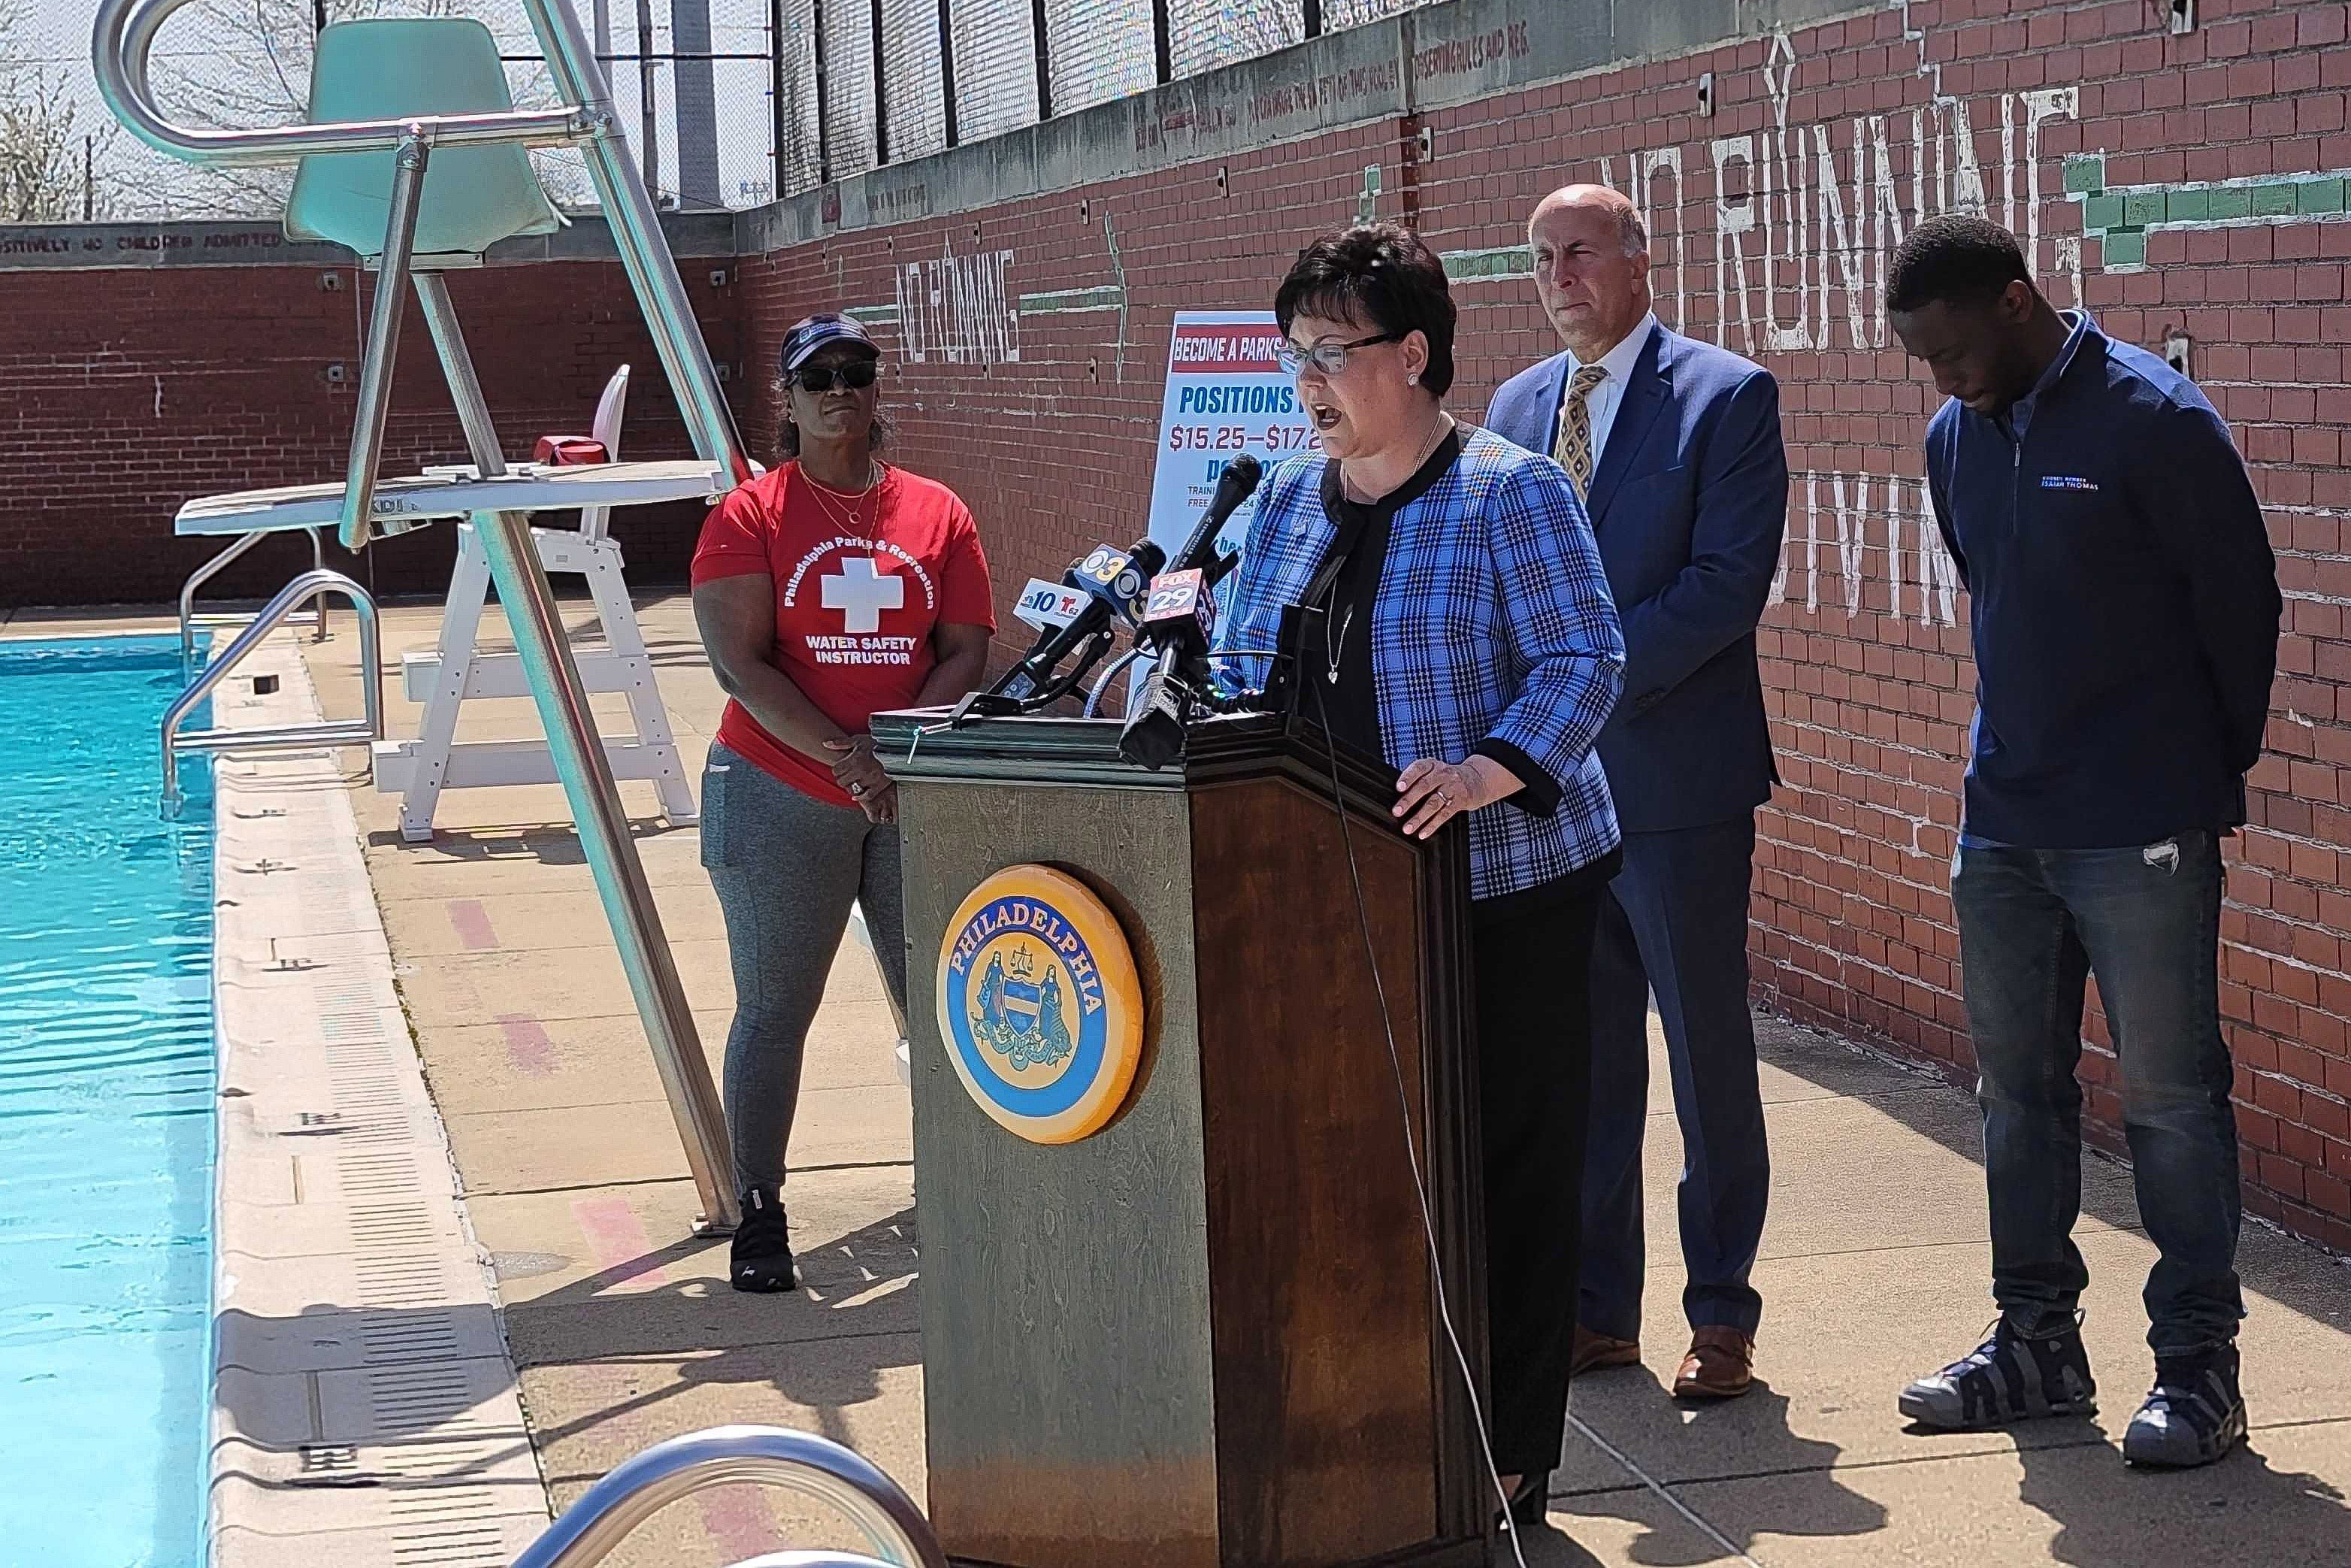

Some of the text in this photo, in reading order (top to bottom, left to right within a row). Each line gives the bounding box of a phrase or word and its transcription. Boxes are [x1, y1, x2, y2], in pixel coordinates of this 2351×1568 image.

[1456, 35, 1483, 74] RULES
[1485, 28, 1504, 62] AND
[1174, 337, 1282, 362] BECOME A PARKS
[1179, 386, 1294, 413] POSITIONS
[1188, 486, 1215, 495] TRAINI
[2066, 482, 2098, 490] THOMAS
[1188, 498, 1209, 507] FREE
[784, 536, 934, 610] Philadelphia Parks & Recreation
[1096, 556, 1127, 582] 3
[1159, 571, 1193, 589] FOX
[1031, 590, 1057, 613] 10
[1068, 607, 1079, 616] 62
[1151, 586, 1194, 612] 29
[806, 635, 917, 650] WATER SAFETY
[815, 651, 912, 665] INSTRUCTOR
[951, 903, 1105, 1016] PHILADELPHIA
